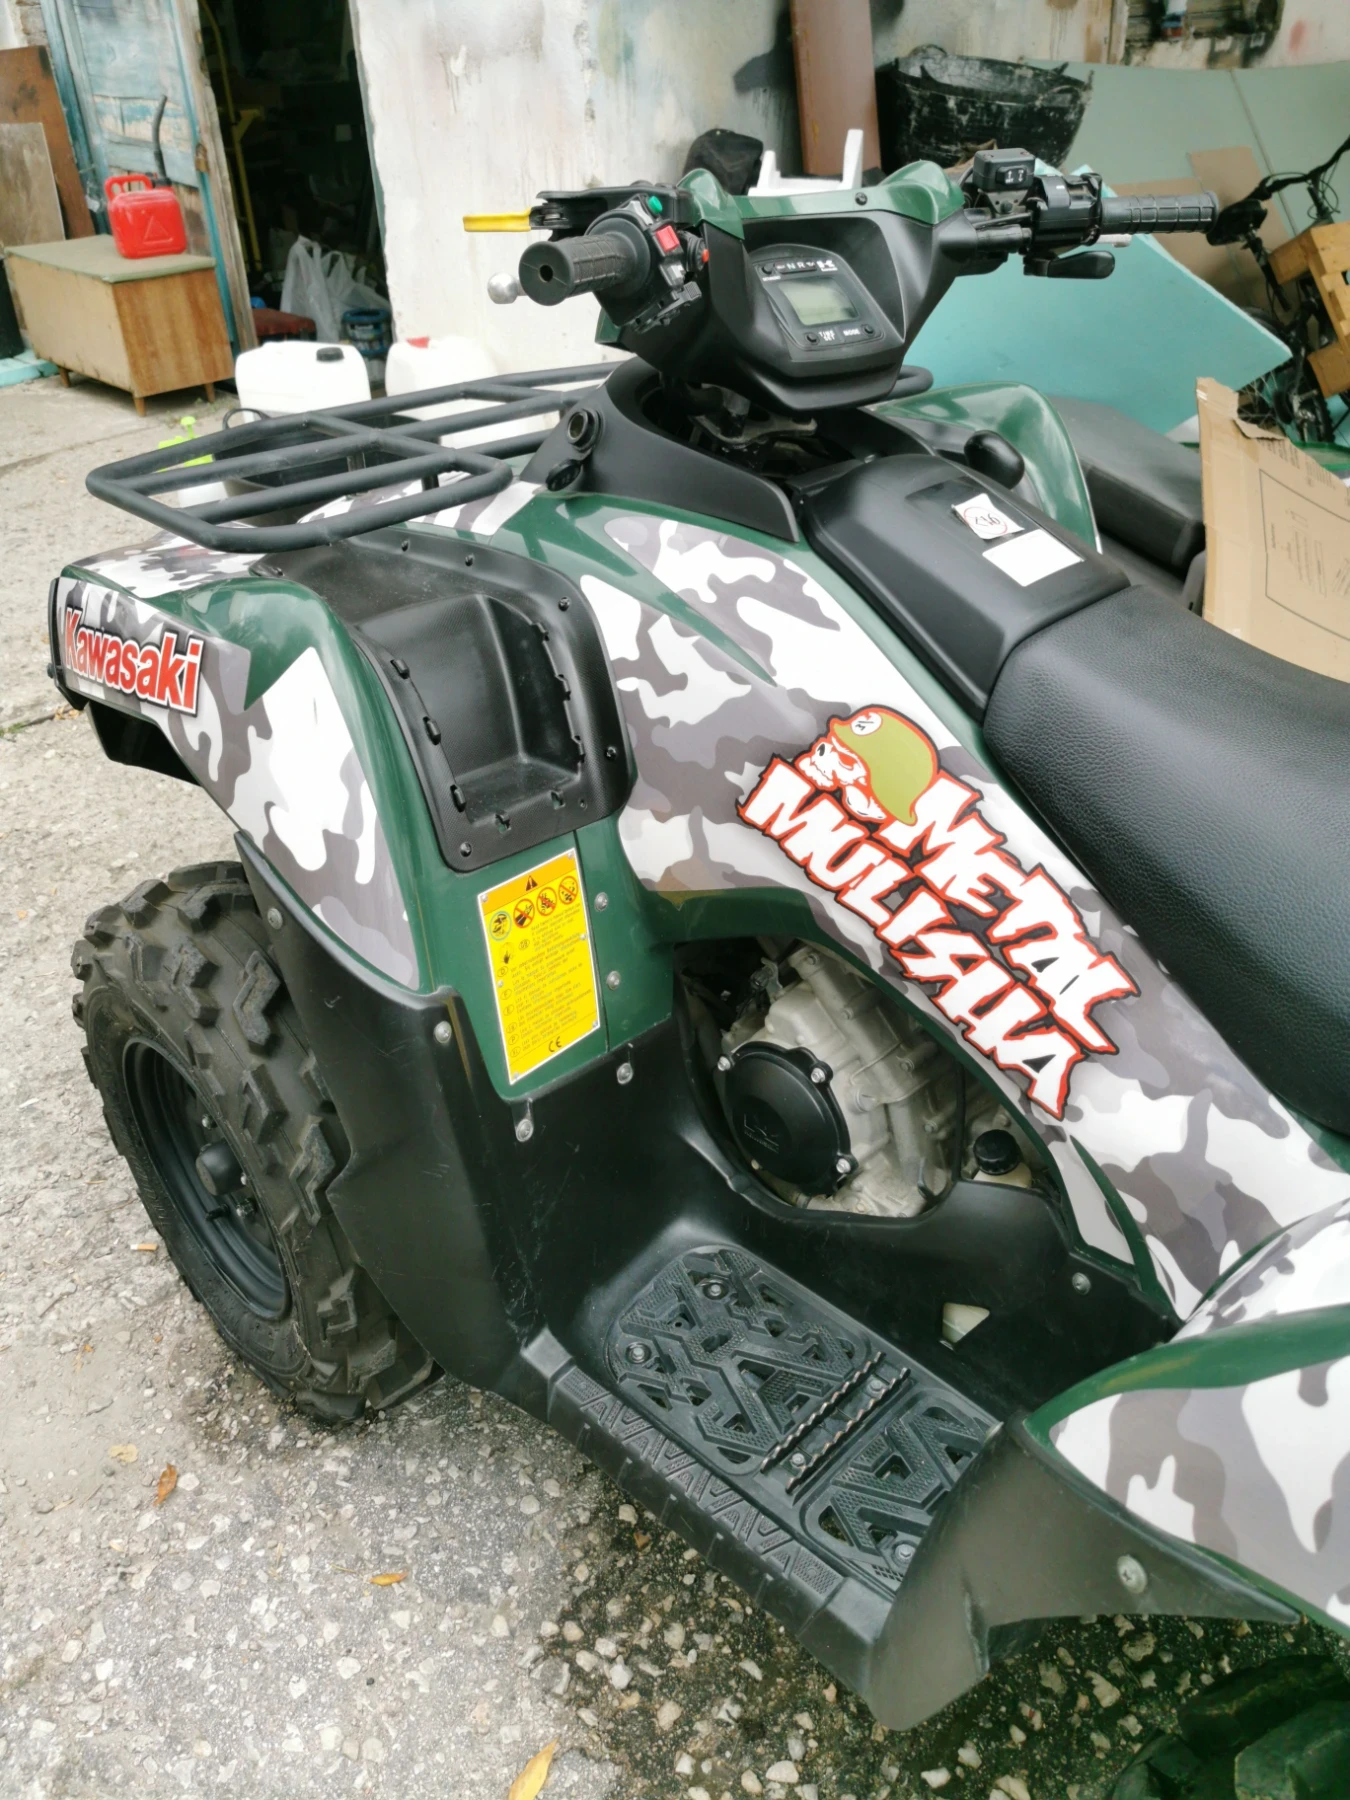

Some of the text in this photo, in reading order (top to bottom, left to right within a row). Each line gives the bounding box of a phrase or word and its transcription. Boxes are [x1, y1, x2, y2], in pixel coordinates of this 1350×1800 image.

[786, 262, 796, 270] N
[66, 606, 204, 715] Kawasaki
[736, 754, 1086, 1120] MULISHA
[875, 772, 1141, 1054] METAL
[548, 1036, 562, 1052] CE
